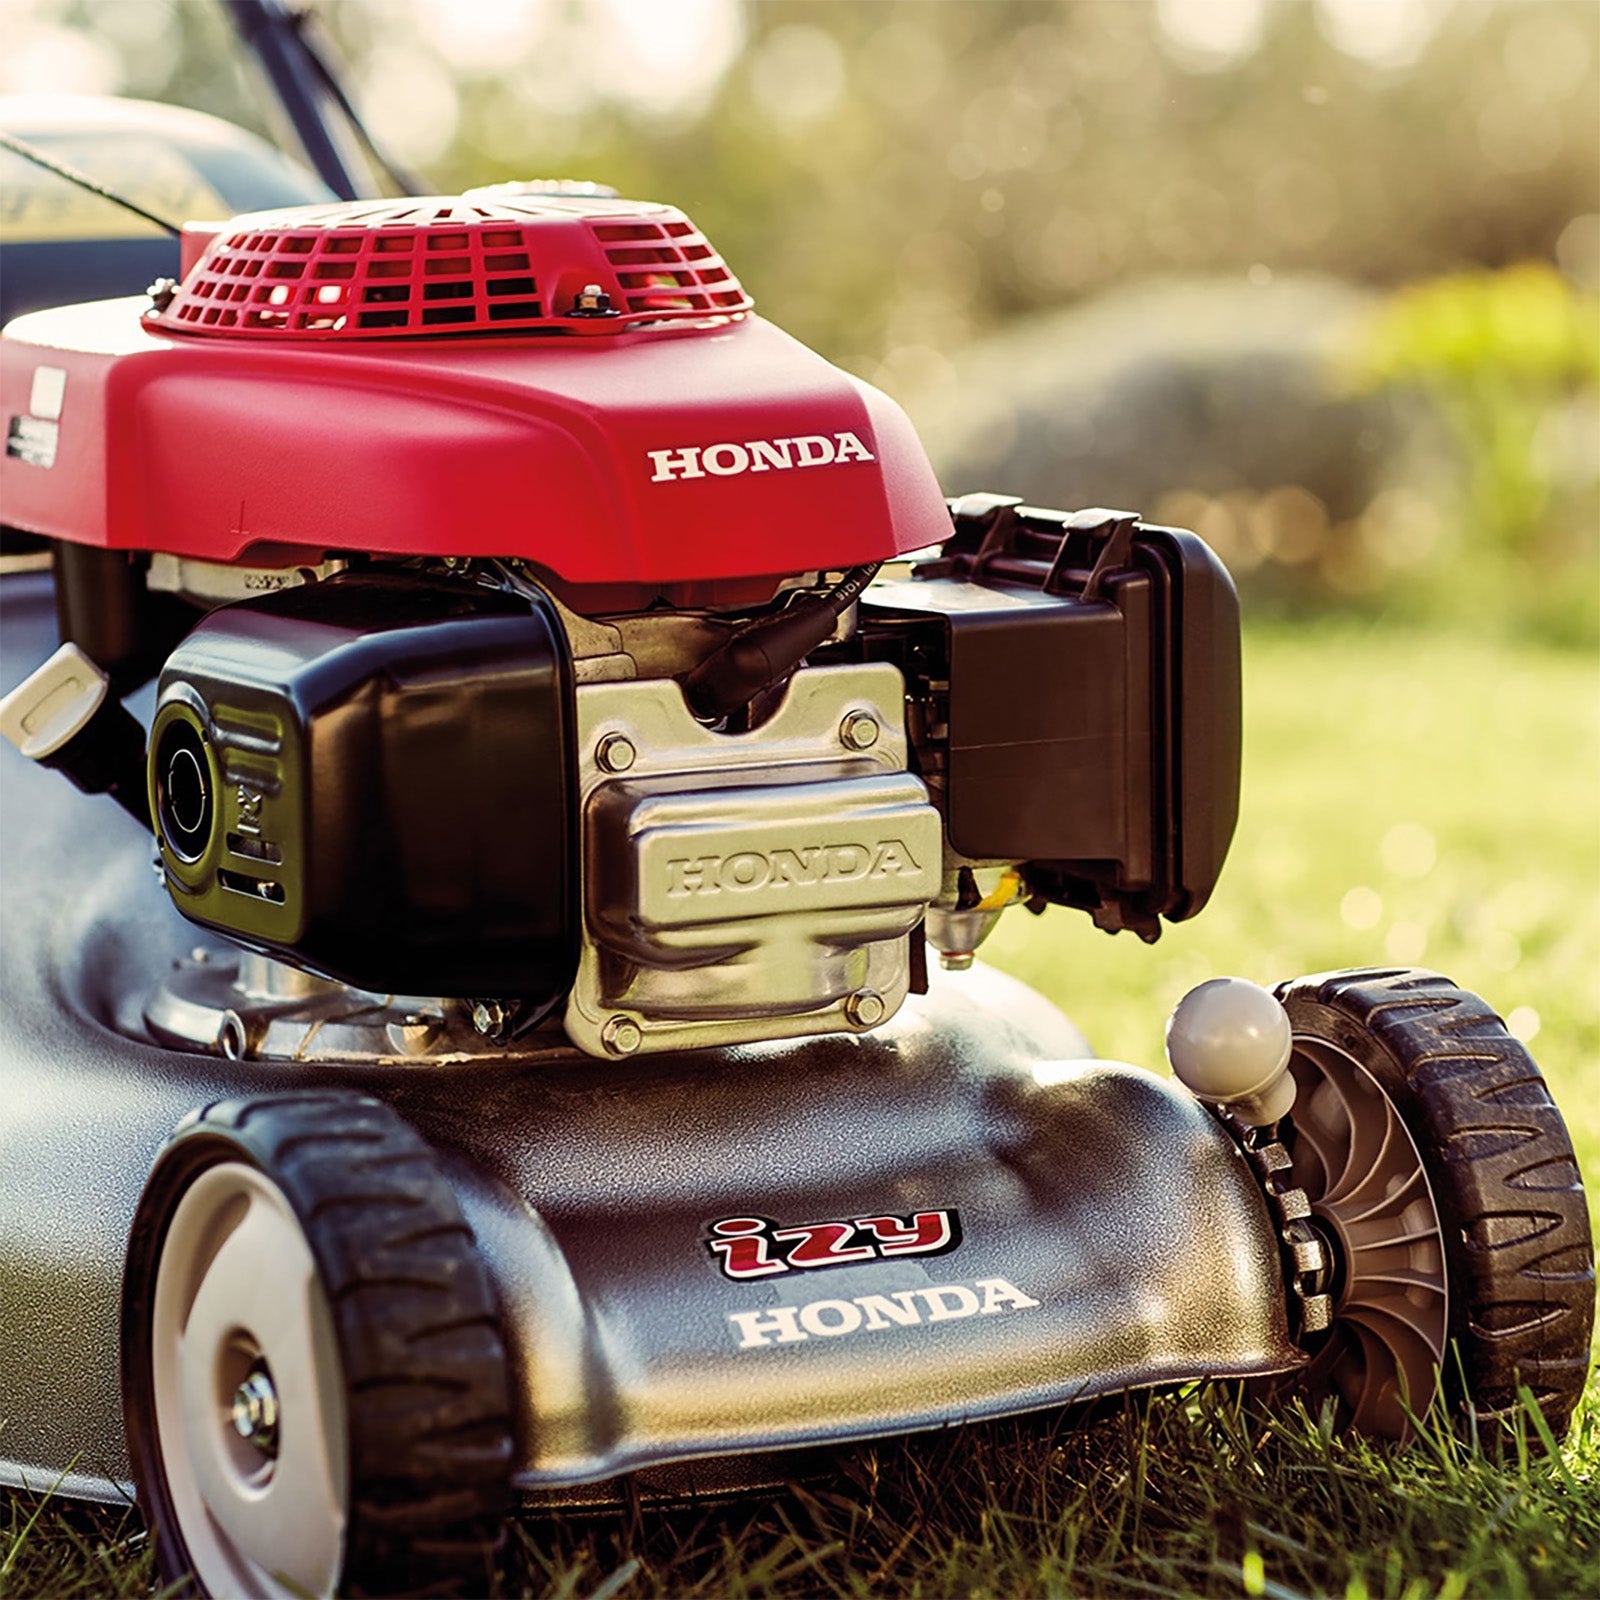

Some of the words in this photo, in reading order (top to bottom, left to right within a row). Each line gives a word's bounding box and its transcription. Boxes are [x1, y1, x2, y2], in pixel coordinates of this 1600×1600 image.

[647, 431, 875, 482] HONDA
[666, 839, 922, 897] HONDA
[710, 1210, 952, 1278] izy
[729, 1278, 1040, 1348] HONDA
